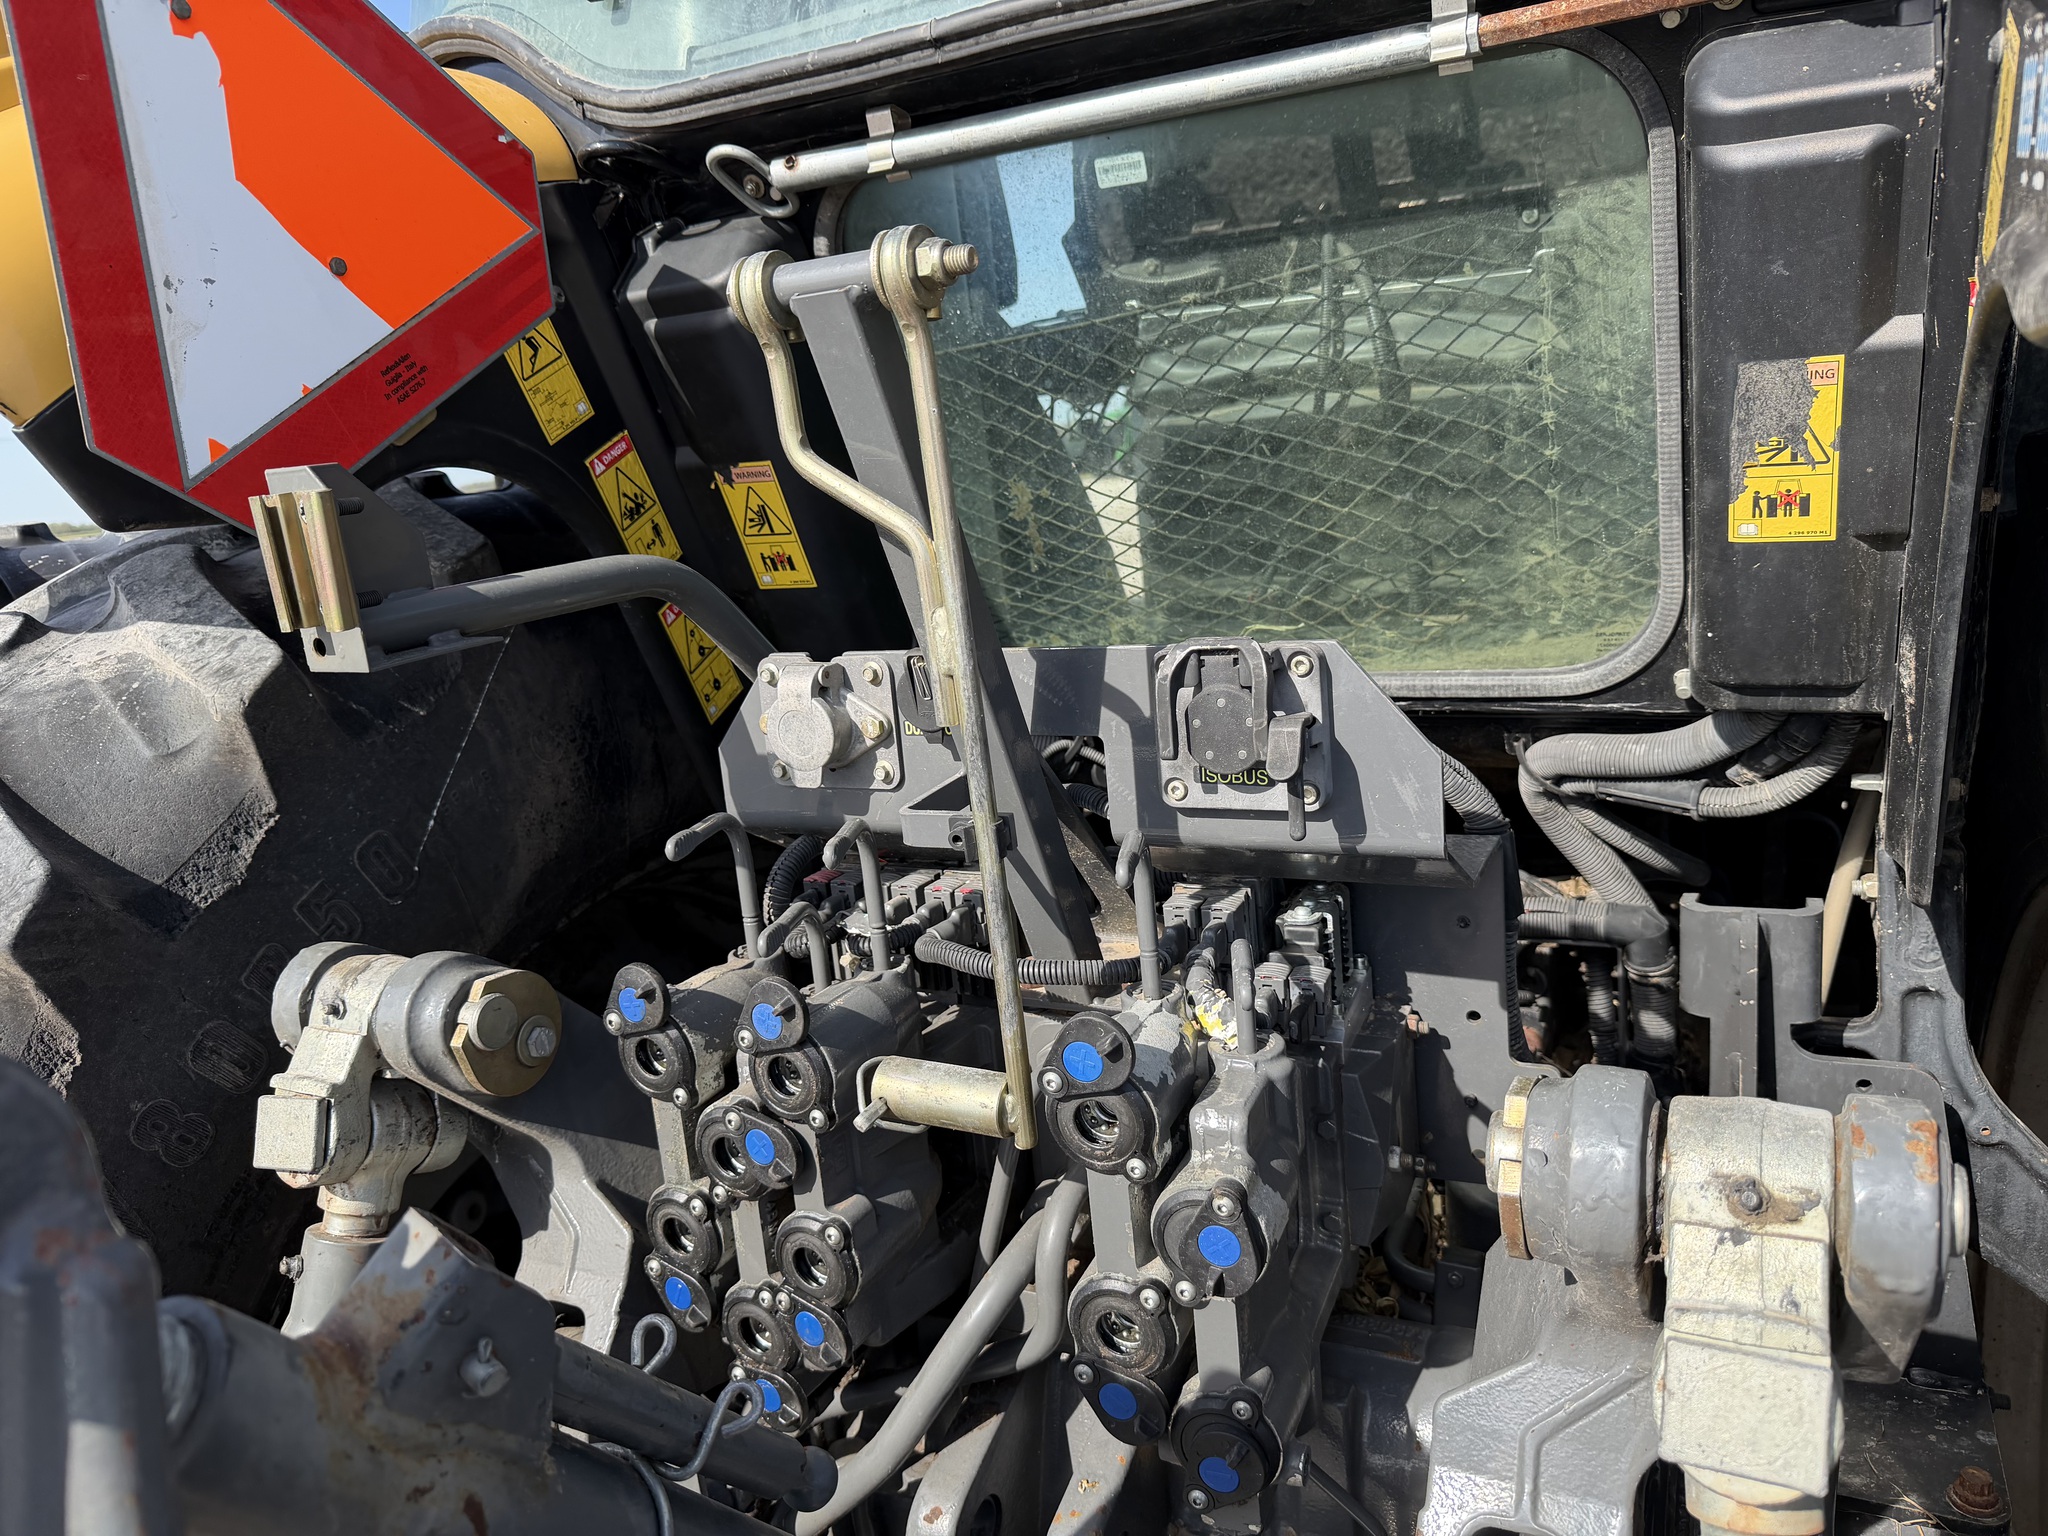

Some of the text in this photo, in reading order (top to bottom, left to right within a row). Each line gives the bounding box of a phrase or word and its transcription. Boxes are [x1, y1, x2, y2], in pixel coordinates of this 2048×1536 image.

[404, 361, 417, 372] Italy
[391, 373, 418, 396] compliance
[417, 365, 428, 376] with
[1806, 369, 1835, 380] ING
[602, 441, 627, 465] DANGER
[733, 470, 771, 480] WARNING
[1201, 767, 1269, 785] ISOBUS
